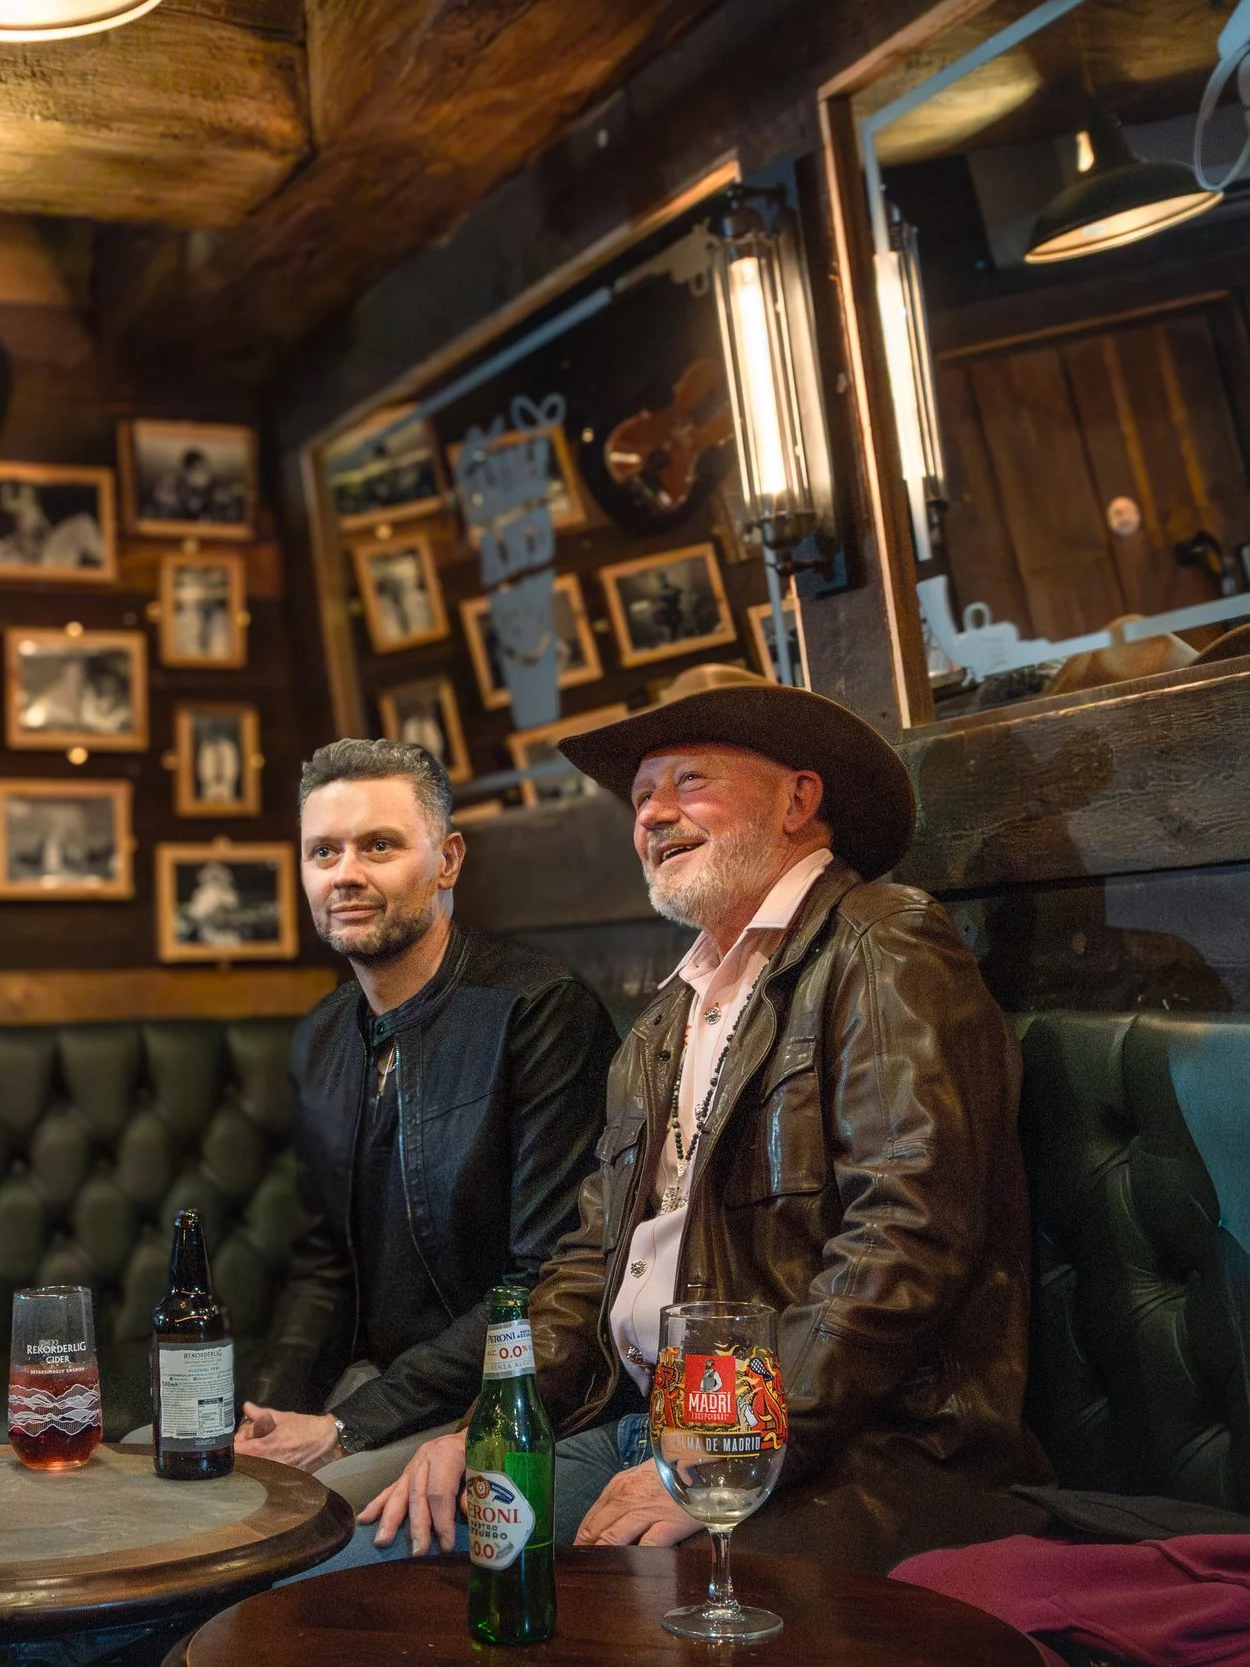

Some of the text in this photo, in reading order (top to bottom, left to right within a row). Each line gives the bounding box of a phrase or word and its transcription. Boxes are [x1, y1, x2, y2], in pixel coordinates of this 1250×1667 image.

[26, 1341, 86, 1354] REKORDERLIG
[45, 1355, 70, 1364] CIDER
[706, 1438, 718, 1452] DE
[723, 1436, 761, 1452] MADRID
[468, 1502, 519, 1524] ERONI
[469, 1526, 508, 1540] ZZURRO
